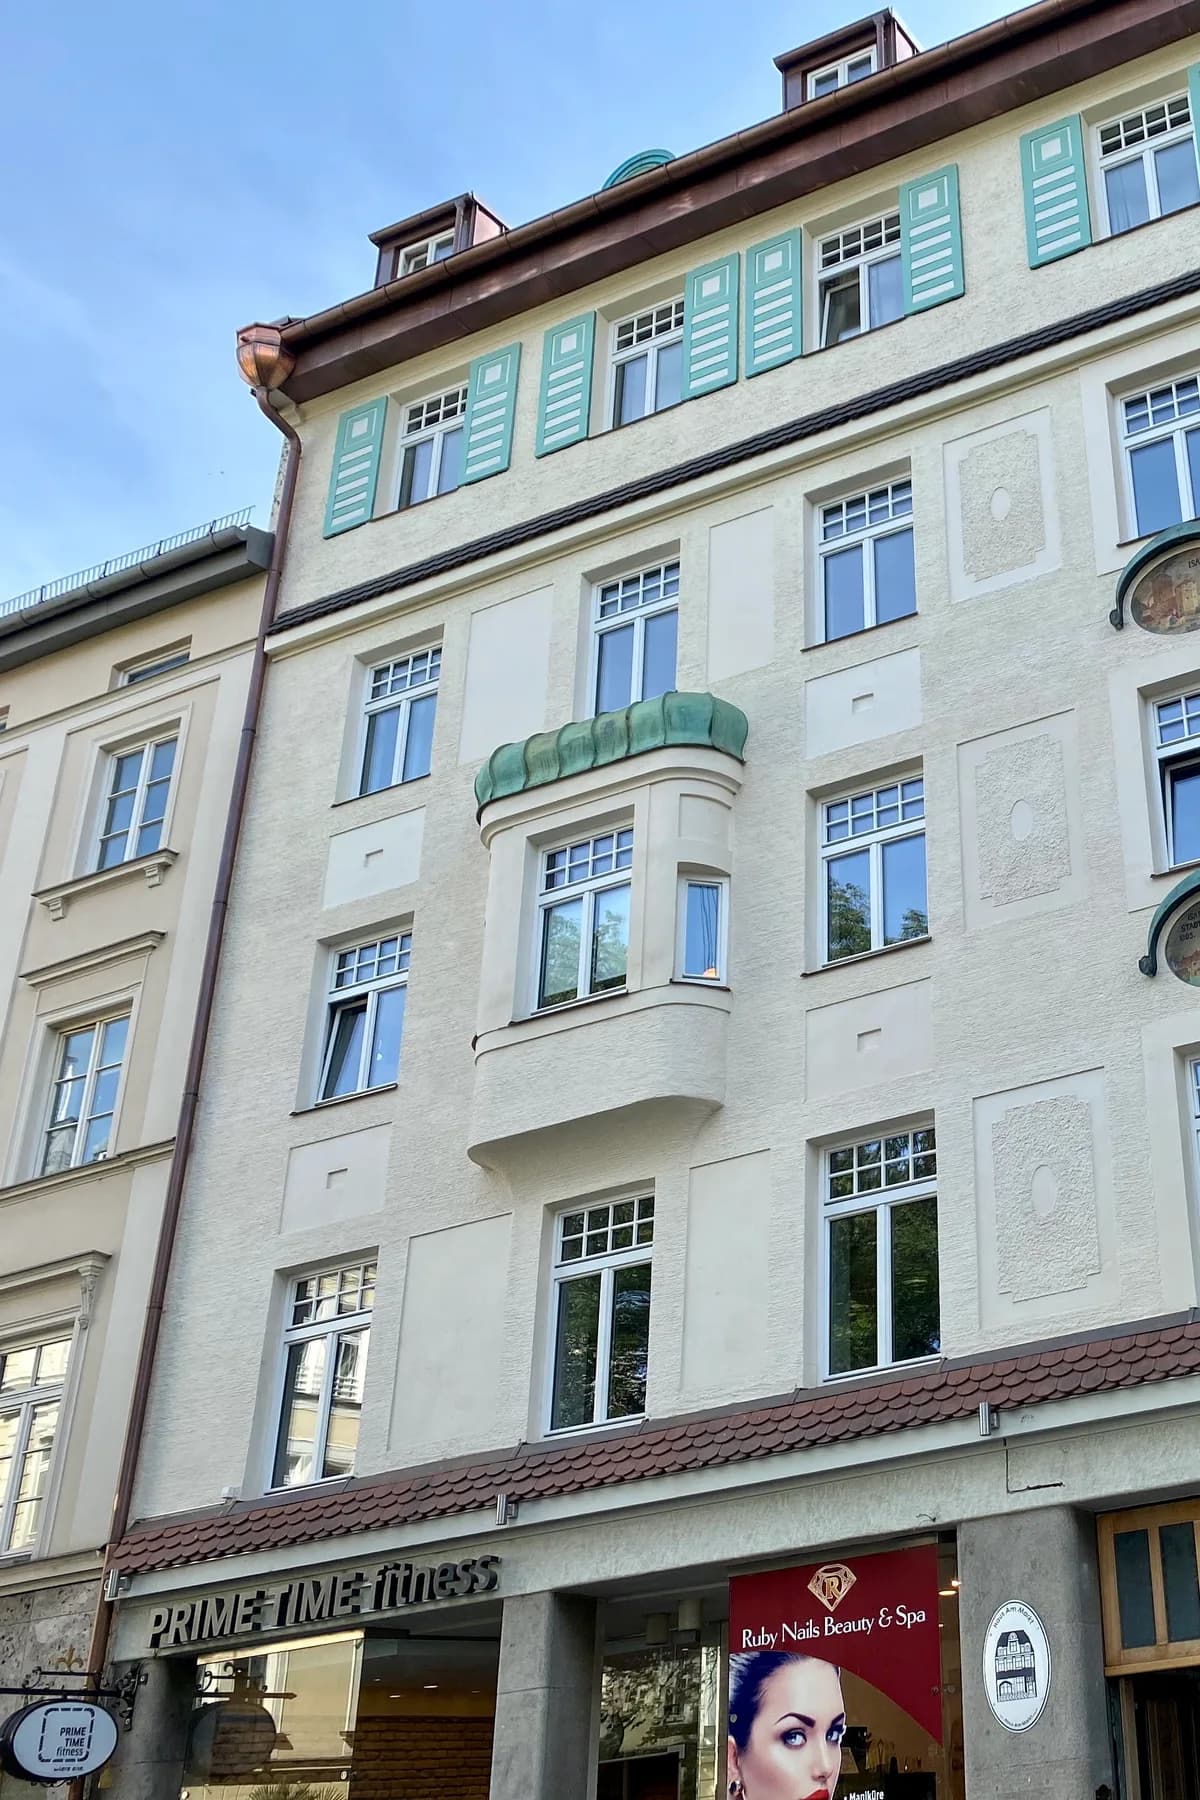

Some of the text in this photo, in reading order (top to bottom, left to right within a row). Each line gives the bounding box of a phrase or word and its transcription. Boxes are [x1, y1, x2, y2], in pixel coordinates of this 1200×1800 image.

[149, 1555, 501, 1648] PRIME TIME fitness
[742, 1605, 926, 1649] Ruby Nails Beauty & Spa
[60, 1727, 87, 1737] PRIME
[65, 1738, 85, 1748] TIME
[56, 1746, 84, 1757] fitness
